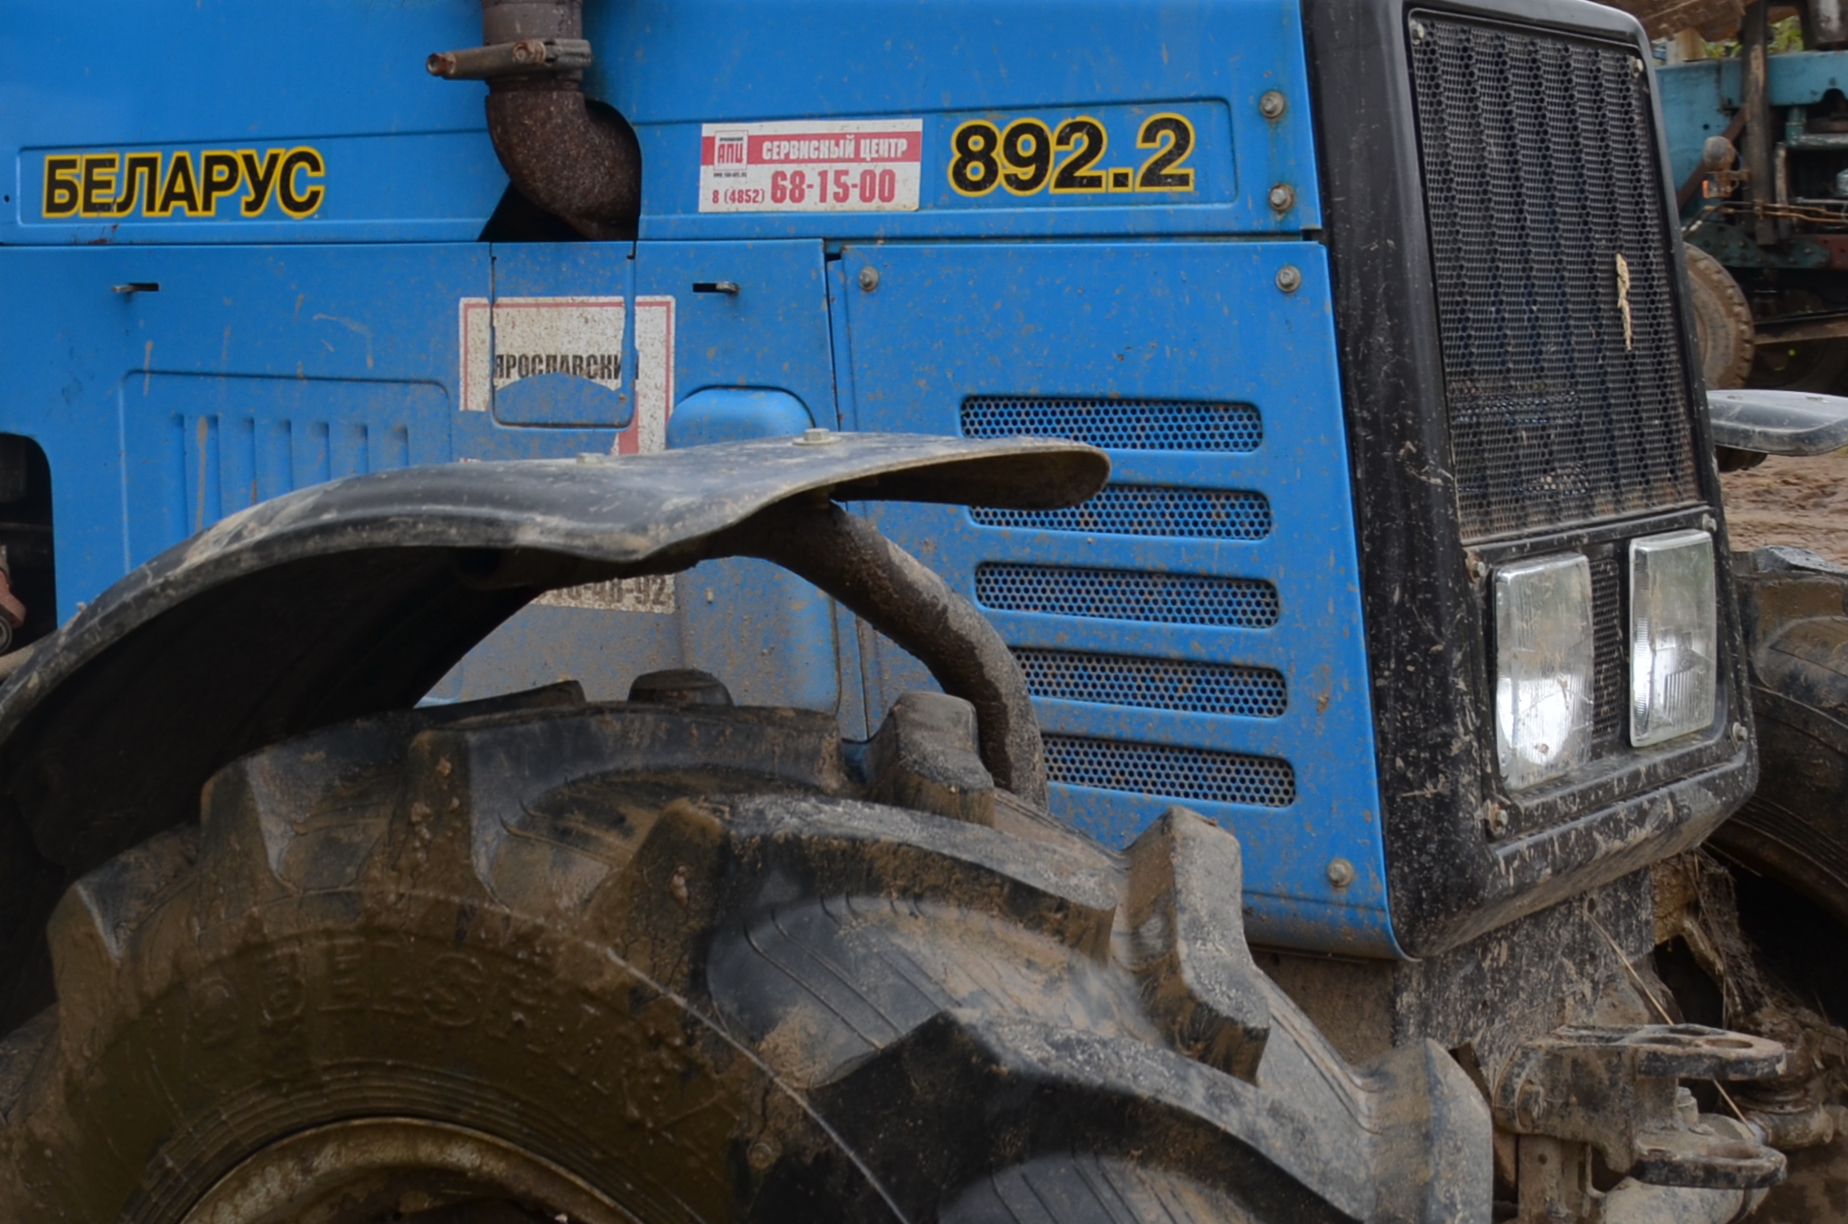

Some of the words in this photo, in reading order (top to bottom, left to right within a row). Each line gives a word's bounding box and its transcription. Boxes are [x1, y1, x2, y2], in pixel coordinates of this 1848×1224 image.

[717, 143, 744, 164] АПЦ
[762, 134, 854, 160] СЕРВИСНЫЙ
[860, 138, 908, 161] ЦЕНТР
[948, 113, 1195, 196] 892.2
[43, 146, 325, 218] БЕЛАРУС
[712, 189, 719, 204] 8
[724, 189, 765, 204] (4852)
[771, 169, 896, 203] 68-15-00
[492, 353, 639, 380] ЯРОСЛАВСКИ
